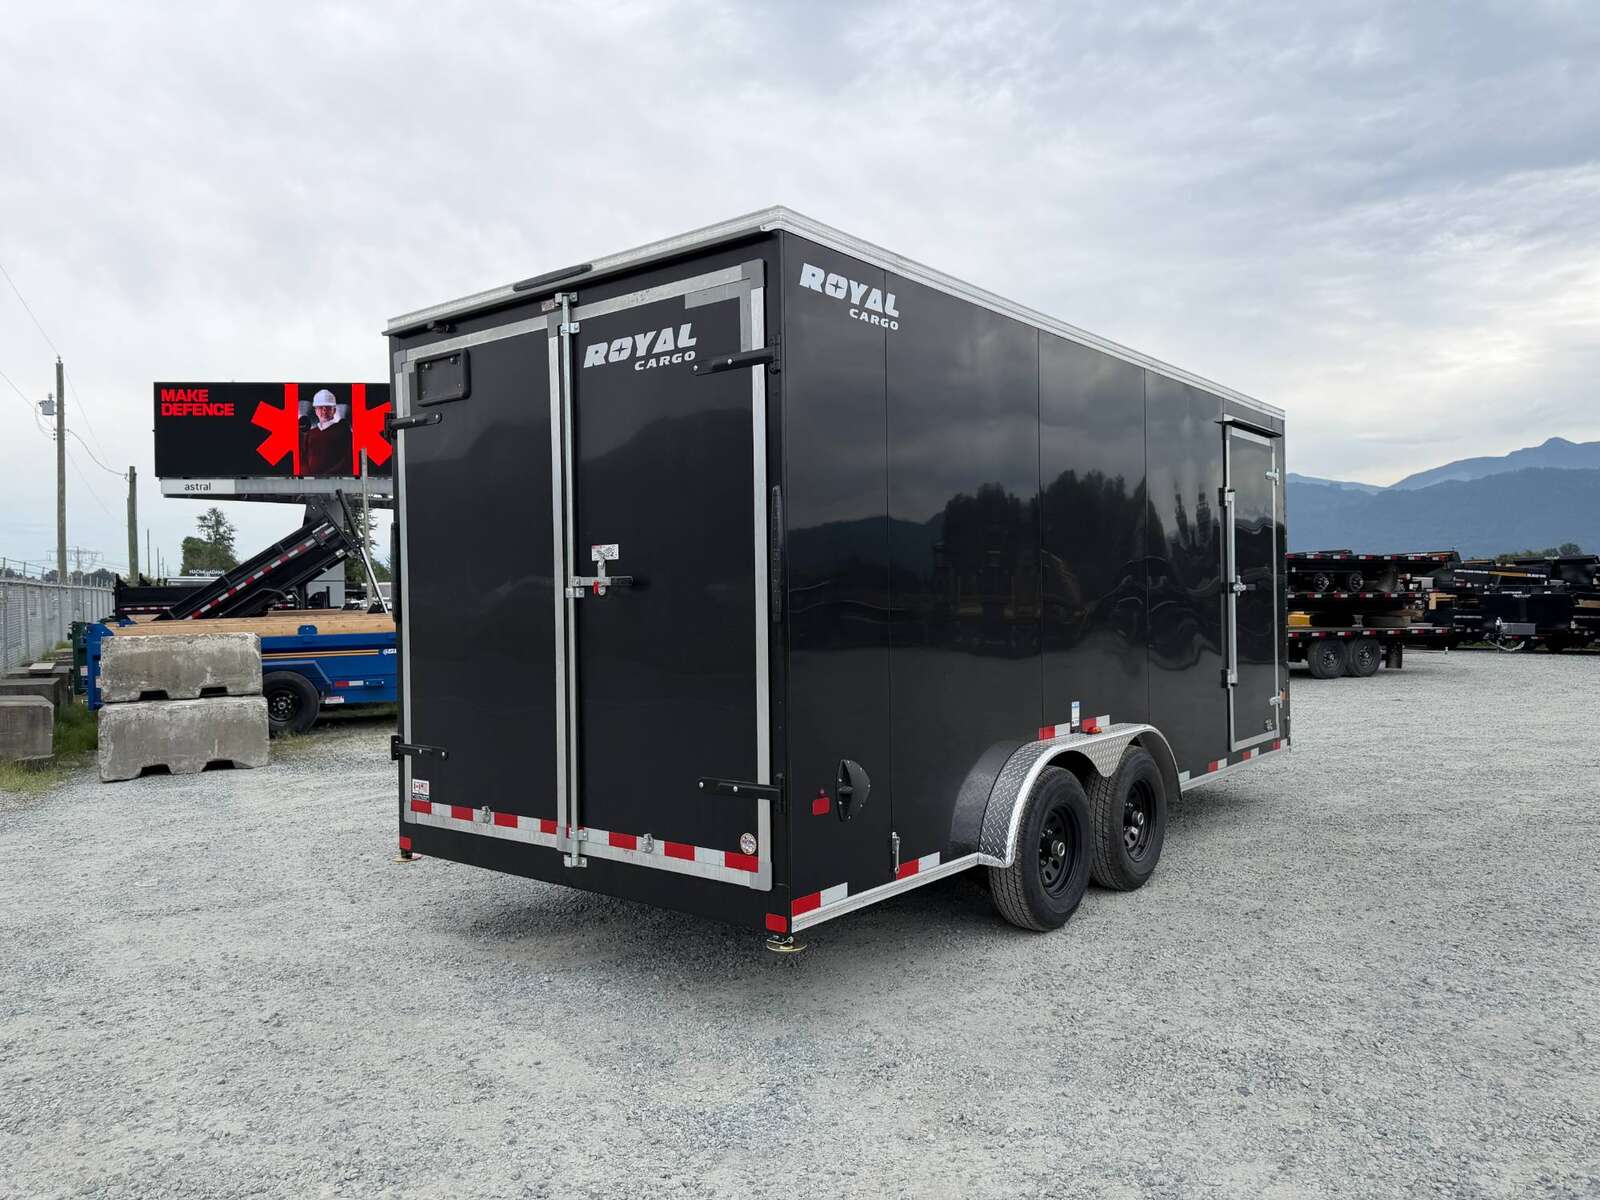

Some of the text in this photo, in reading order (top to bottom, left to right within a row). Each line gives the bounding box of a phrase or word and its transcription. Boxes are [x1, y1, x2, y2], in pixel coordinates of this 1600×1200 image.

[799, 262, 899, 318] ROYAL
[849, 308, 899, 331] CARGO
[583, 322, 697, 368] ROYAL
[634, 350, 696, 371] CARGO
[161, 388, 209, 402] MAKE
[161, 403, 235, 416] DEFENCE
[184, 482, 212, 491] astral
